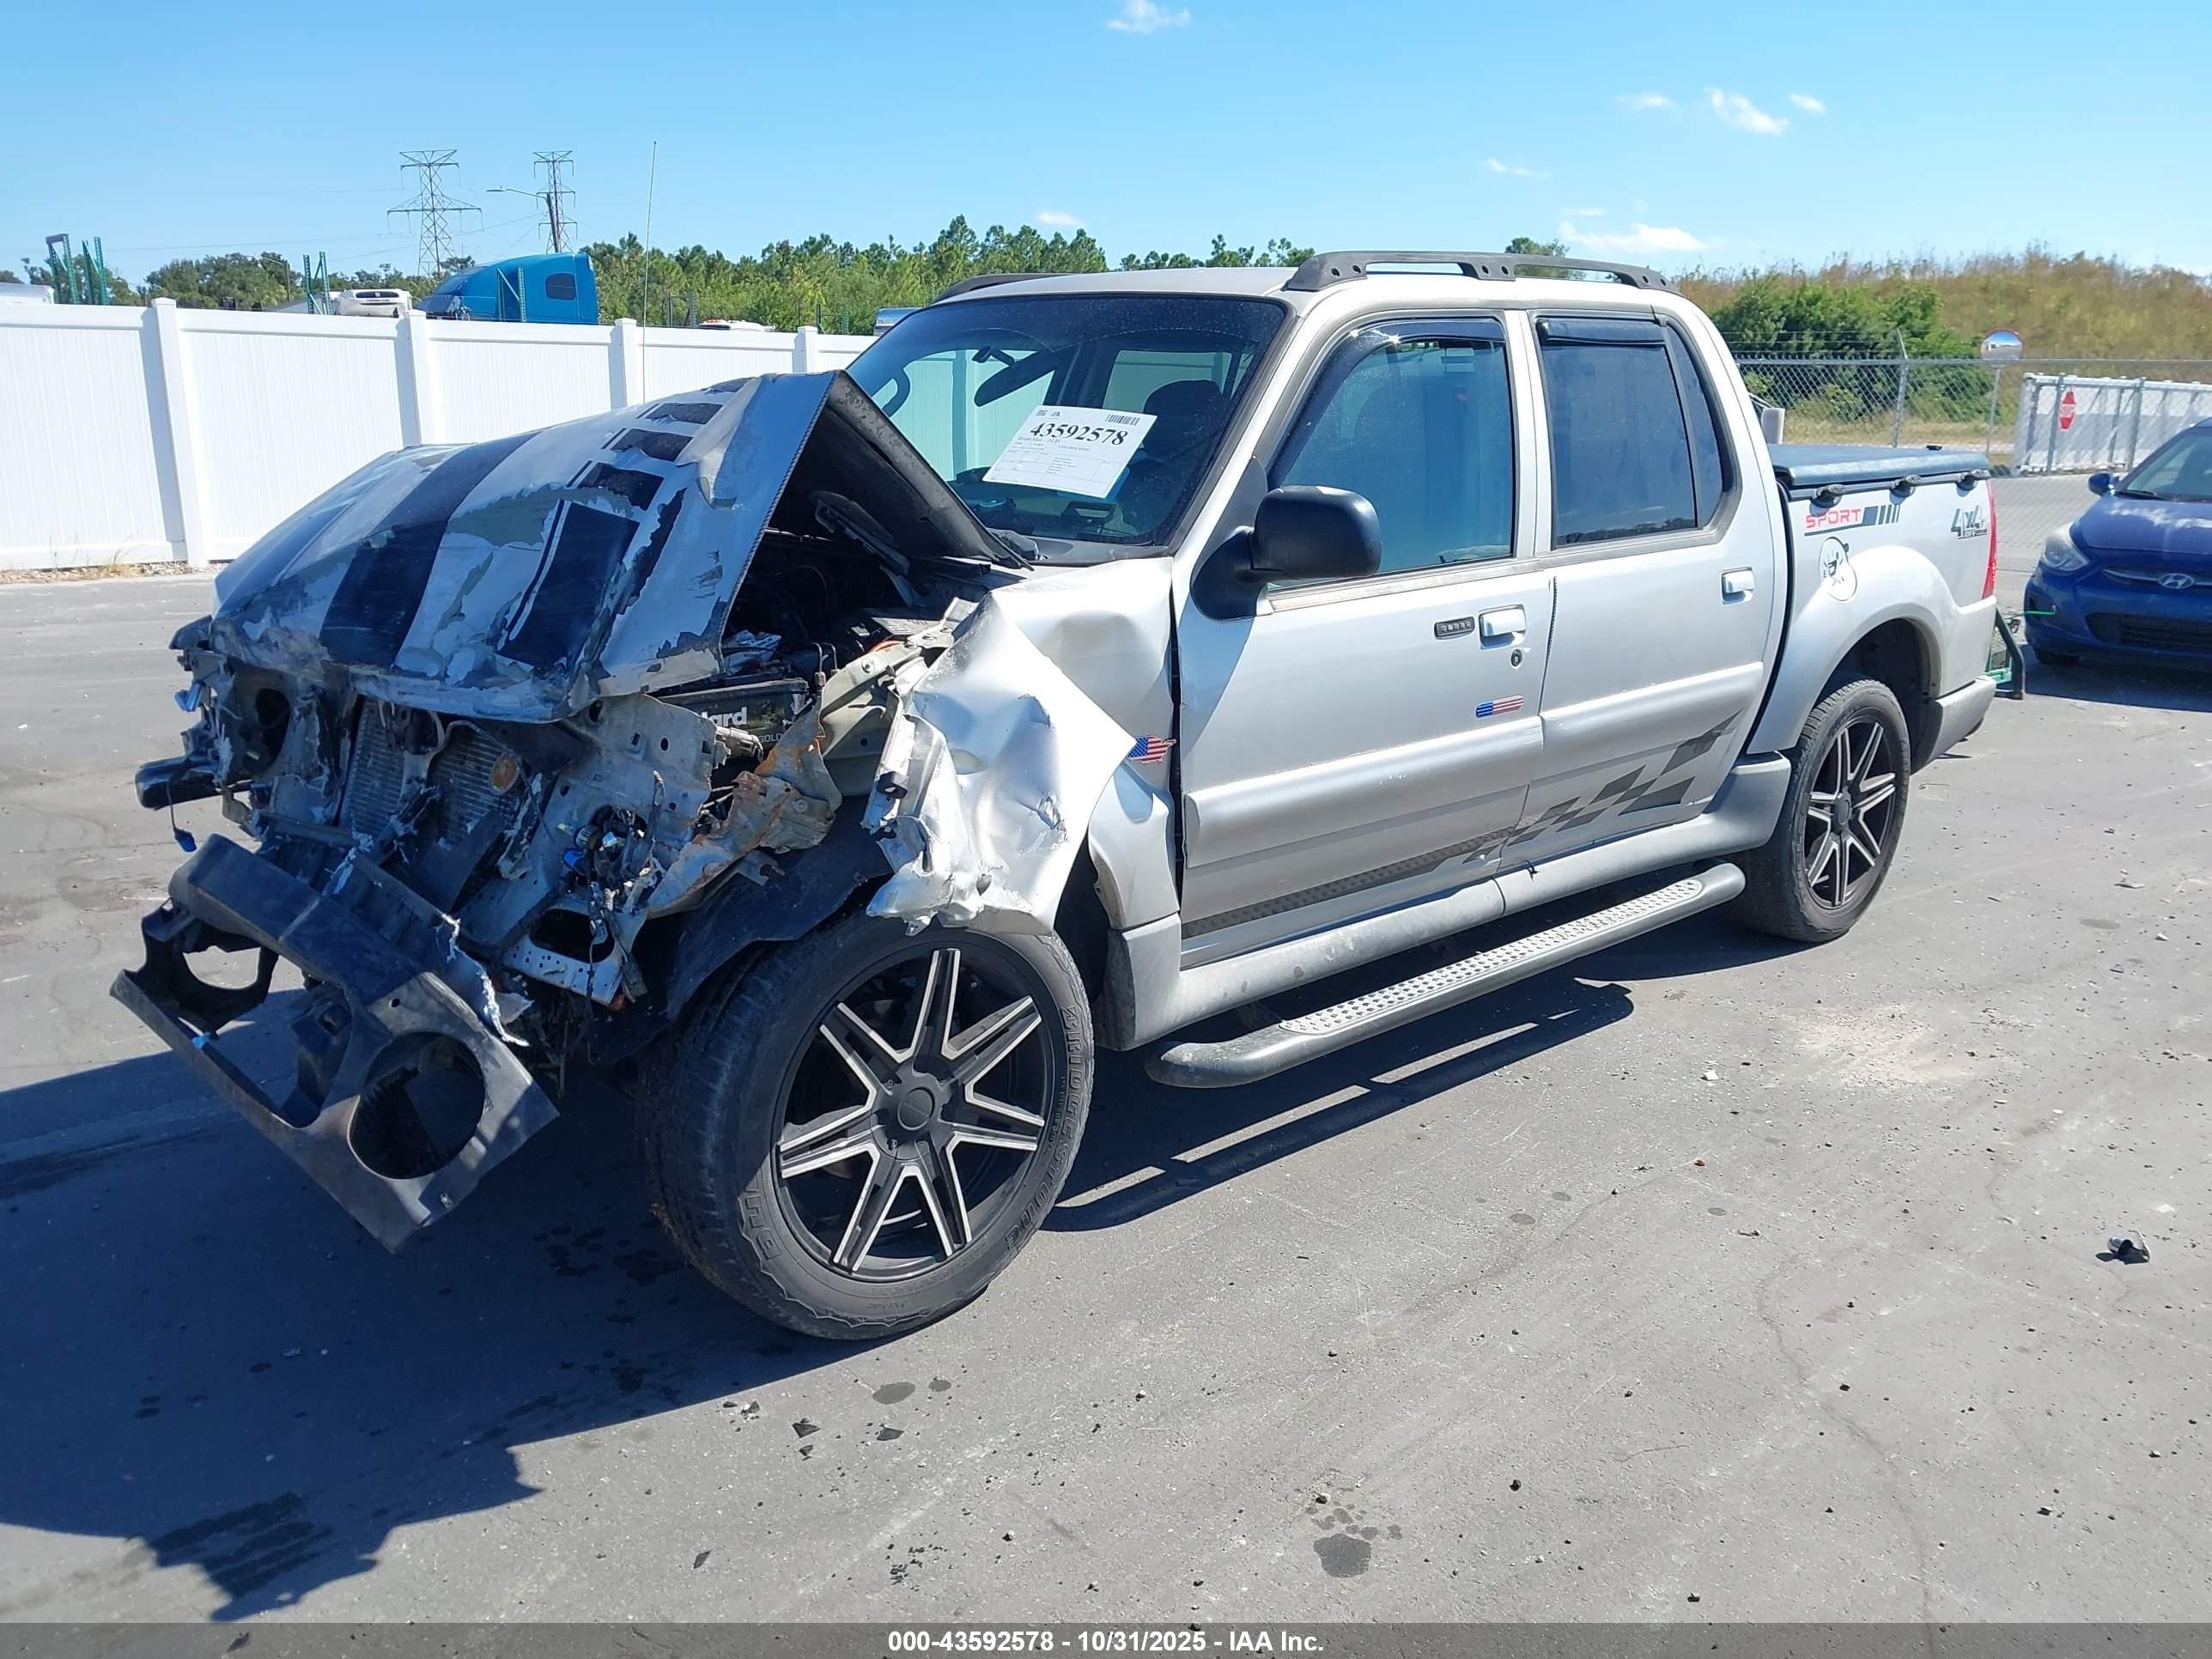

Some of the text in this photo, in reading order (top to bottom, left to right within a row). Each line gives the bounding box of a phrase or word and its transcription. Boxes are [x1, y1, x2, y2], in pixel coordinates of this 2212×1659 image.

[1030, 422, 1128, 446] 43592578
[1806, 508, 1862, 529] SPORT
[758, 732, 783, 744] GOLD
